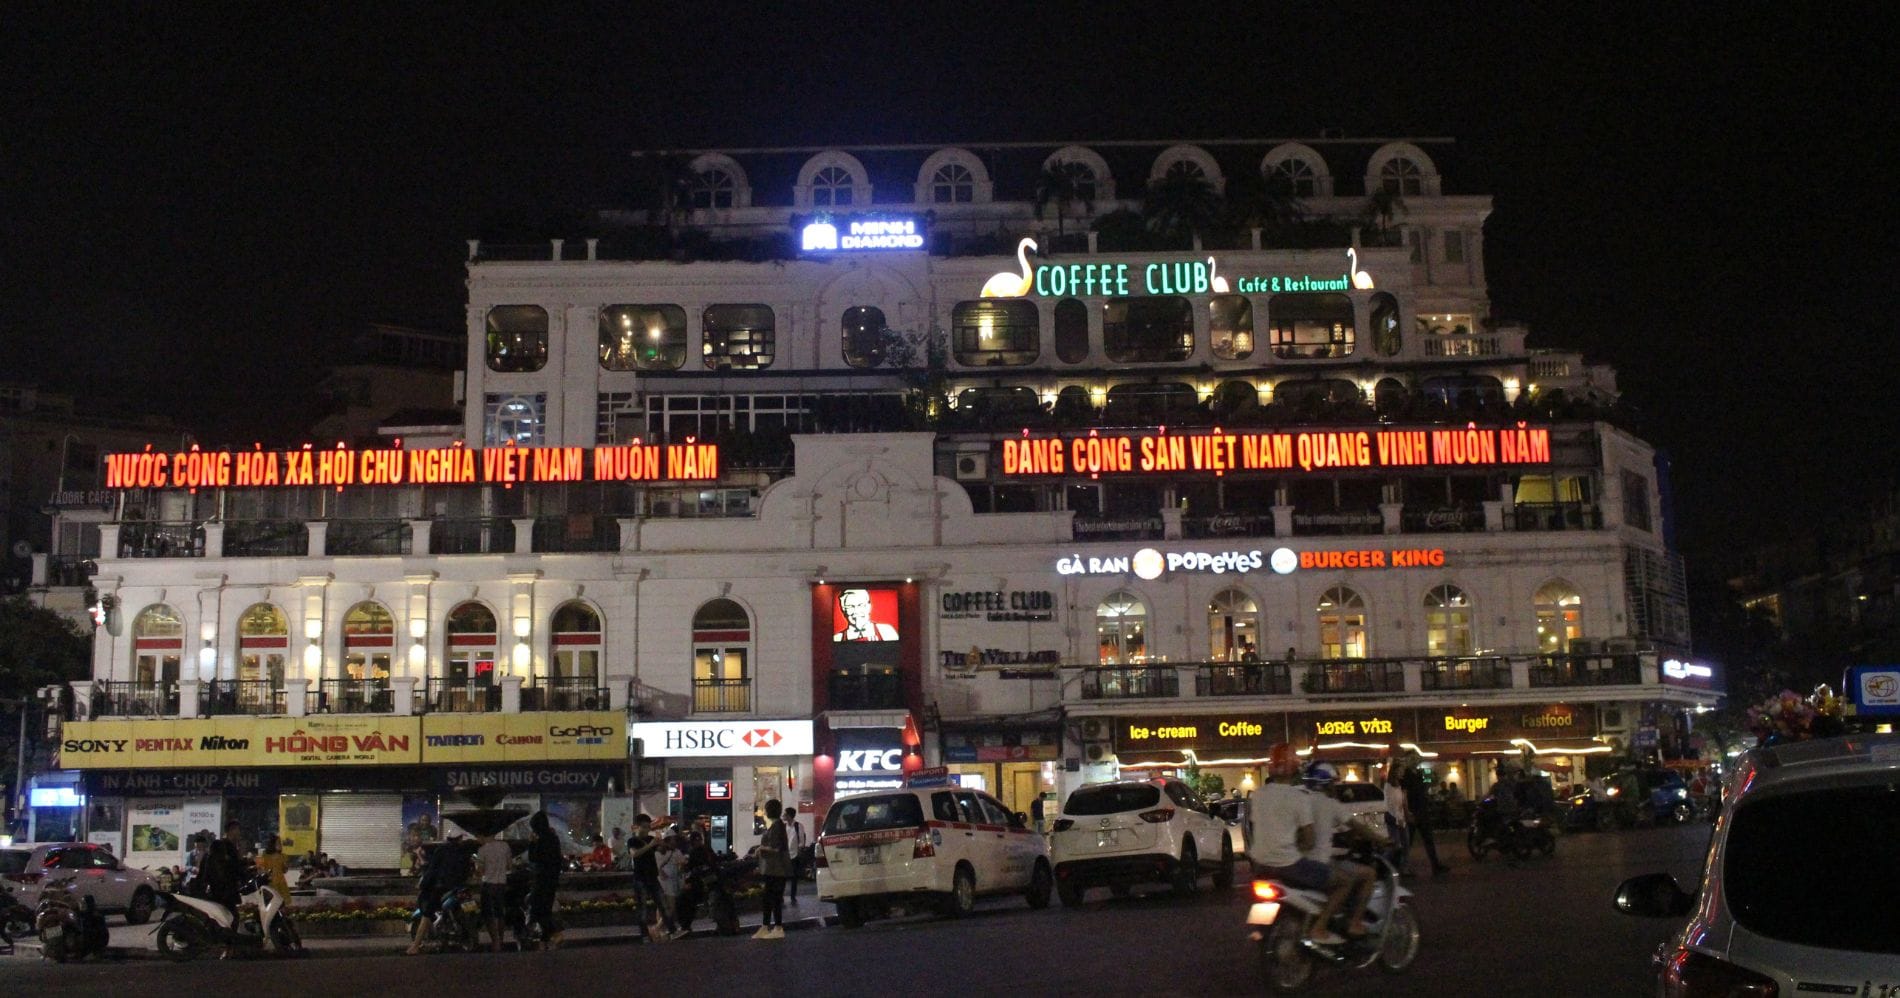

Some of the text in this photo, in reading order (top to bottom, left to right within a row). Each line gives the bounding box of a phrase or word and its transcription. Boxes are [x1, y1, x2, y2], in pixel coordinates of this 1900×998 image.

[851, 221, 915, 235] MINH
[841, 235, 924, 249] DIAMOND
[1036, 261, 1208, 296] COFFEE CLUB
[1239, 274, 1348, 292] Café & Restaurant
[1003, 421, 1550, 479] ĐẢNG CỘNG SẢN VIỆT NAM QUANG VINH MUÔN NĂM
[106, 436, 718, 494] NƯỚC CỘNG HÒA XÃ HỘI CHỦ NGHĨA VIỆT NAM MUÔN NĂM
[1056, 553, 1129, 575] GÀ RAN
[1300, 549, 1444, 569] BURGER KING
[943, 590, 1053, 611] COFFEE CLUB
[1219, 722, 1262, 736] Coffee
[1445, 716, 1489, 733] Burger
[1522, 713, 1573, 728] Fastfood
[64, 739, 128, 753] SONY
[135, 738, 194, 751] PENTAX
[200, 736, 249, 751] Nikon
[351, 730, 410, 752] VÂN
[425, 735, 485, 747] TAMRON
[495, 734, 544, 745] Canon
[550, 725, 614, 737] GoPro
[665, 729, 734, 749] HSBC
[836, 749, 903, 772] KFC
[103, 774, 120, 788] IN
[446, 769, 601, 788] SAMSUNG Galaxy
